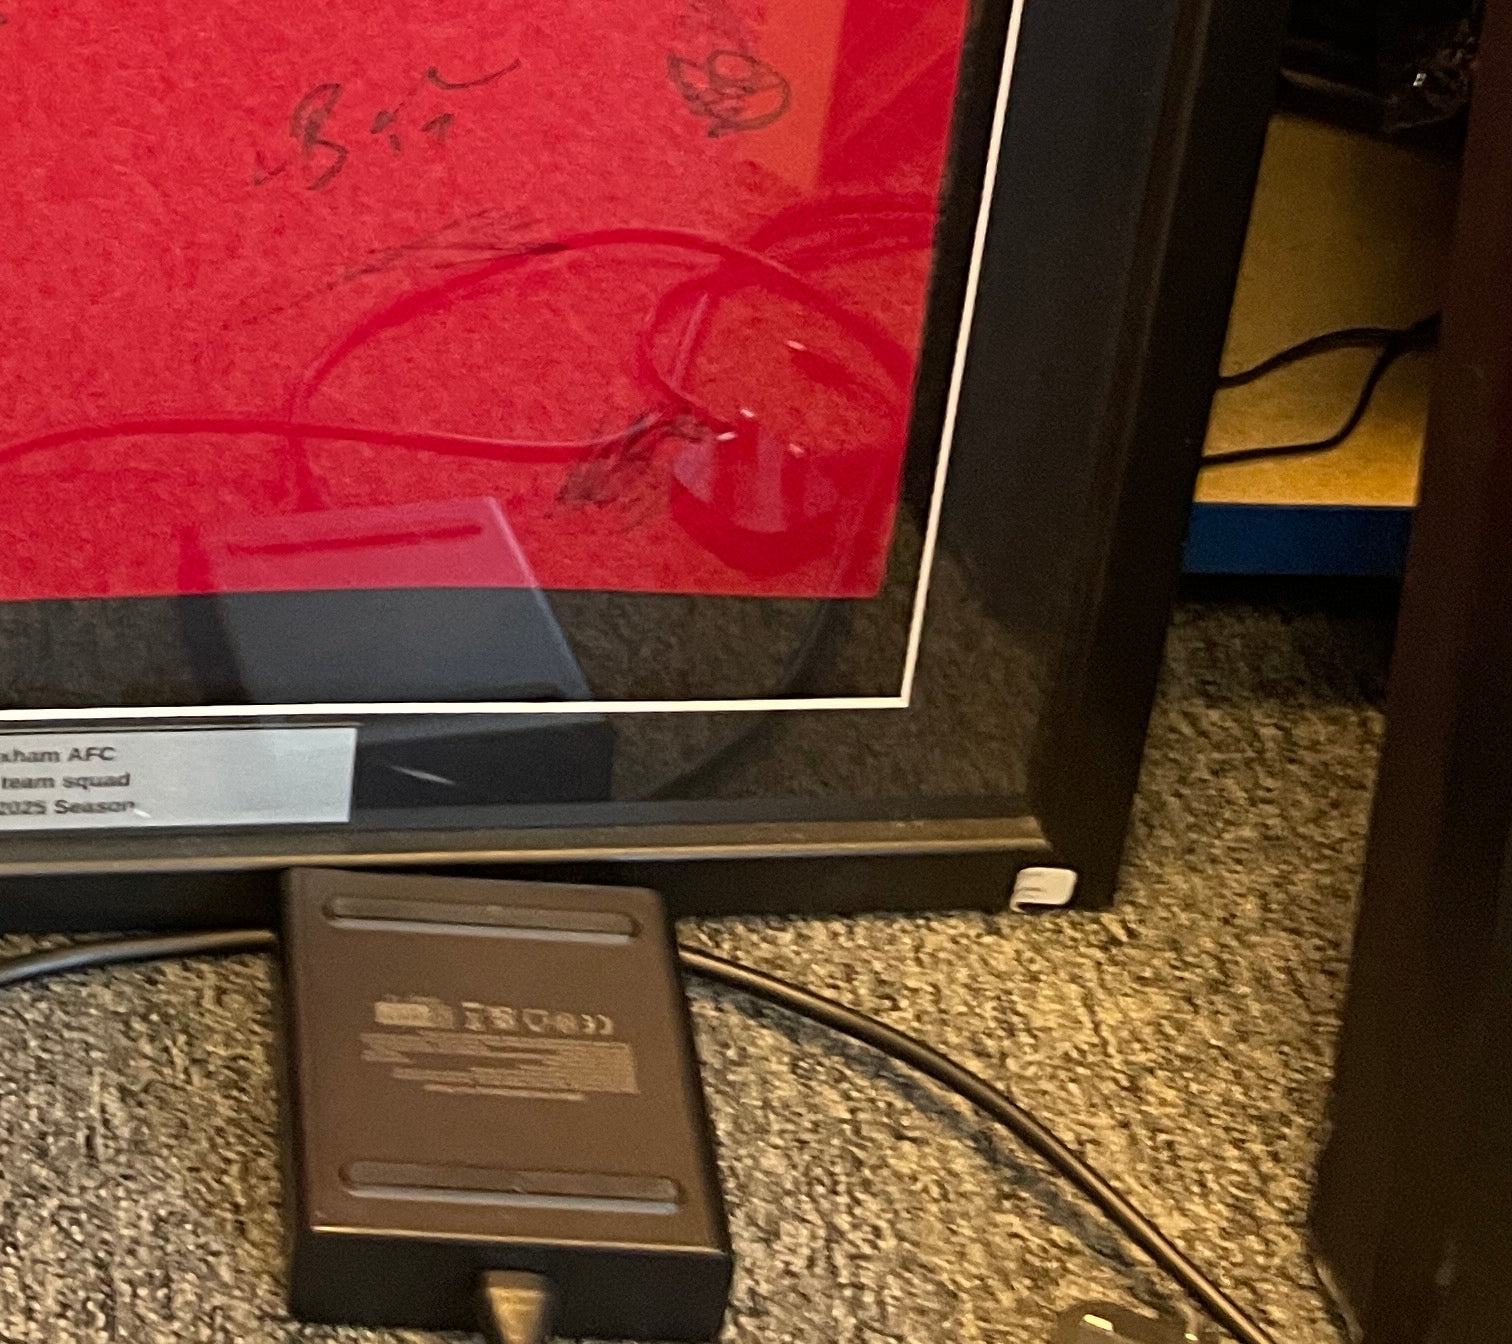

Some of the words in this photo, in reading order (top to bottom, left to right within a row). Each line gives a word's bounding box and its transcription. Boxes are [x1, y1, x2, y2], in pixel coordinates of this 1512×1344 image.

[66, 746, 117, 762] AFC
[0, 774, 56, 790] team
[62, 772, 131, 791] squad
[53, 799, 136, 815] Season
